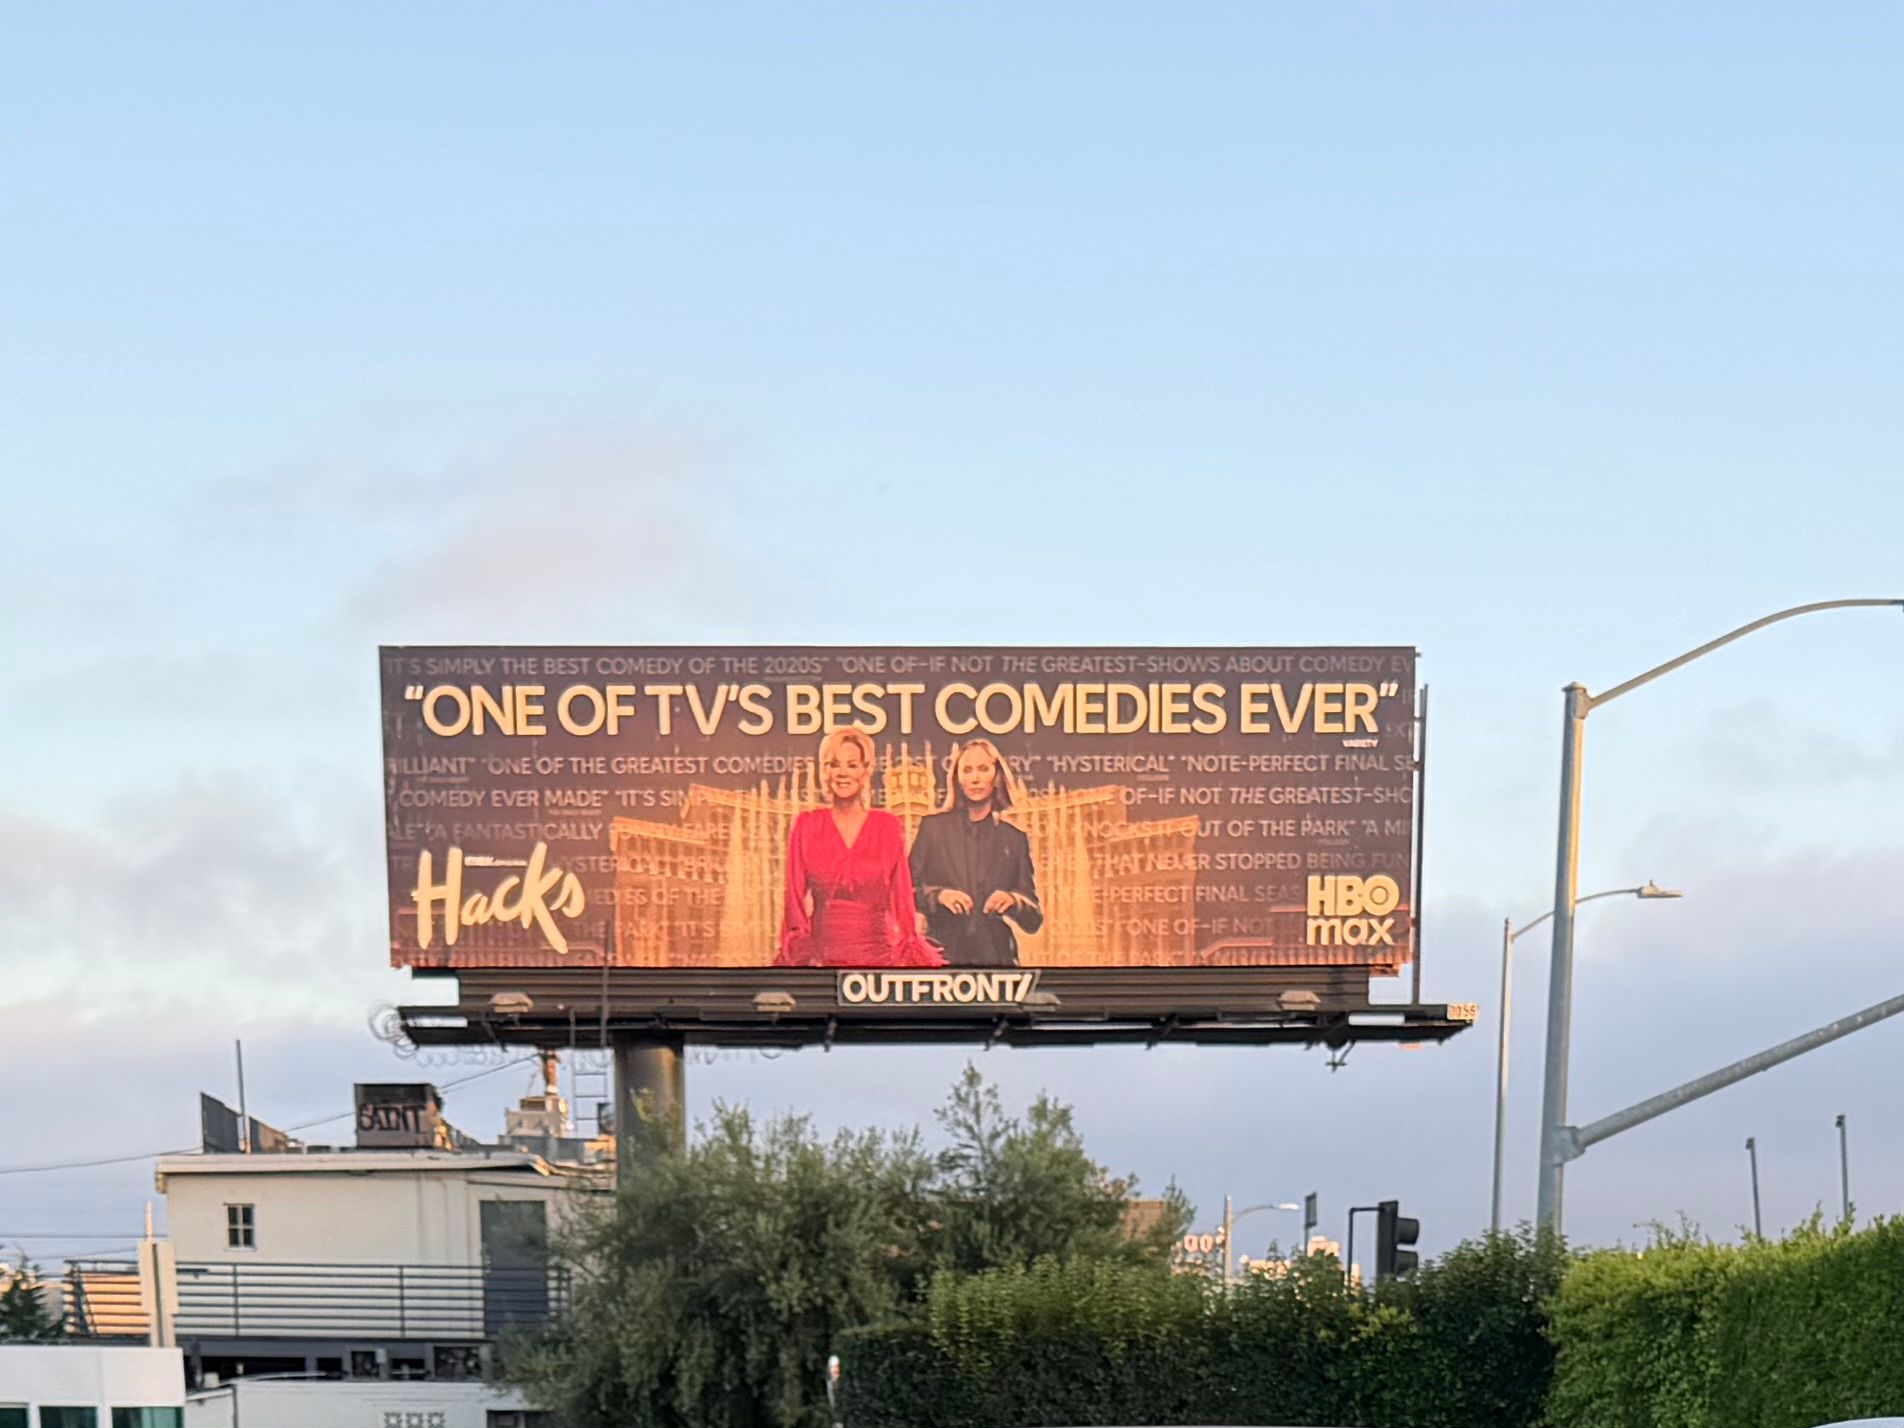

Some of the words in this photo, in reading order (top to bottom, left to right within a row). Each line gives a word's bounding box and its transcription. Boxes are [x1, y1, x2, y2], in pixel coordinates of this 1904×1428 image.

[426, 657, 496, 675] SIMPLY
[500, 657, 538, 675] THE
[543, 657, 590, 675] BEST
[595, 657, 683, 675] COMEDY
[688, 657, 716, 675] OF
[720, 657, 758, 675] THE
[951, 656, 994, 673] NOT
[1002, 656, 1038, 673] THE
[1224, 656, 1294, 673] ABOUT
[1299, 656, 1385, 673] COMEDY
[557, 685, 637, 737] OF
[643, 684, 774, 736] TV'S
[786, 683, 926, 736] BEST
[934, 682, 1229, 735] COMEDIES
[535, 757, 565, 774] OF
[568, 757, 607, 774] THE
[610, 757, 709, 774] GREATEST
[1334, 755, 1390, 772] FINAL
[398, 789, 486, 807] COMEDY
[490, 789, 540, 807] EVER
[1179, 788, 1229, 805] NOT
[1230, 788, 1265, 805] THE
[453, 823, 603, 841] FANTASTICALLY
[1227, 820, 1255, 838] OF
[1258, 820, 1296, 838] THE
[1214, 853, 1302, 870] STOPPED
[1306, 852, 1367, 869] BEING
[411, 842, 586, 954] Hacks
[1195, 886, 1250, 903] FINAL
[1306, 874, 1400, 917] HBO
[1306, 917, 1395, 946] max
